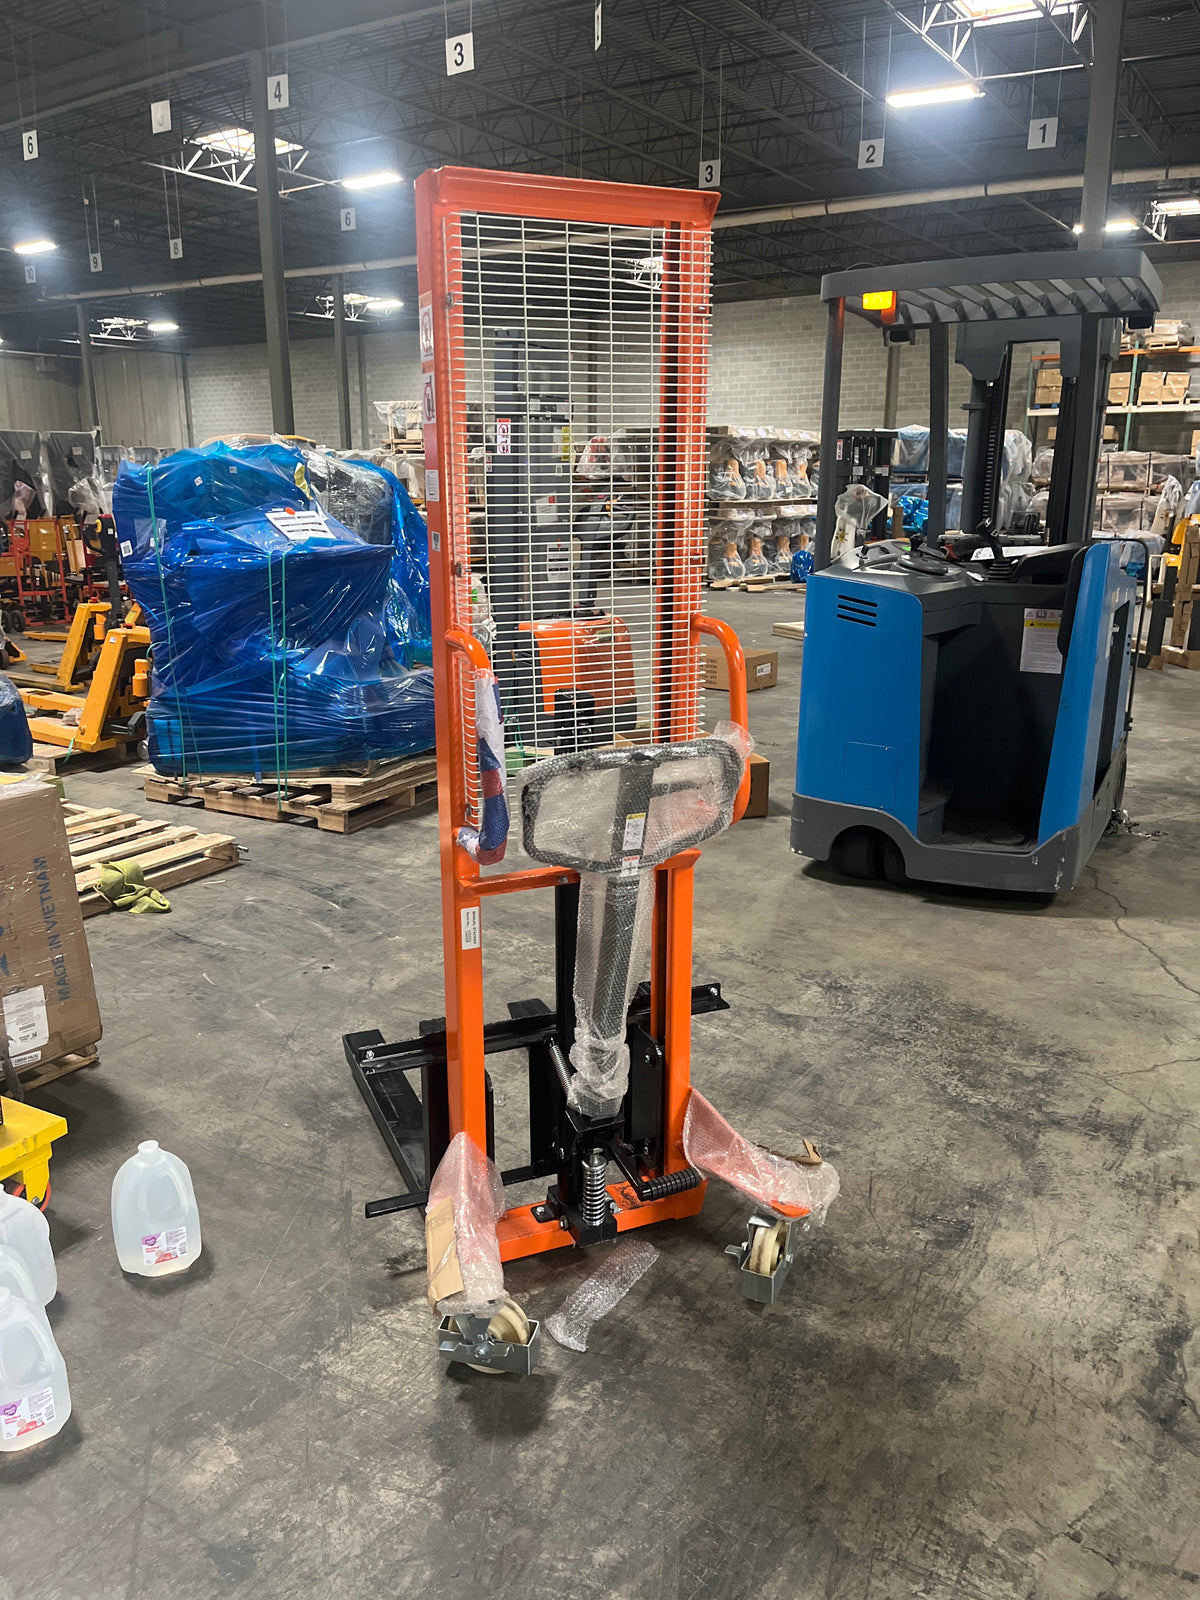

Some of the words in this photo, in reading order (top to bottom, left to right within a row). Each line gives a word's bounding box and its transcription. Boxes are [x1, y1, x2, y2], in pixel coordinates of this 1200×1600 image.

[453, 42, 464, 67] 3
[274, 81, 281, 102] 4
[1040, 123, 1046, 143] 1
[27, 135, 34, 155] 6
[865, 144, 876, 164] 2
[705, 165, 713, 183] 3
[345, 212, 350, 226] 6
[174, 242, 178, 255] 8
[93, 256, 98, 268] 9
[33, 856, 58, 932] VIETNAM
[48, 933, 62, 950] IN
[52, 955, 70, 1001] MADE
